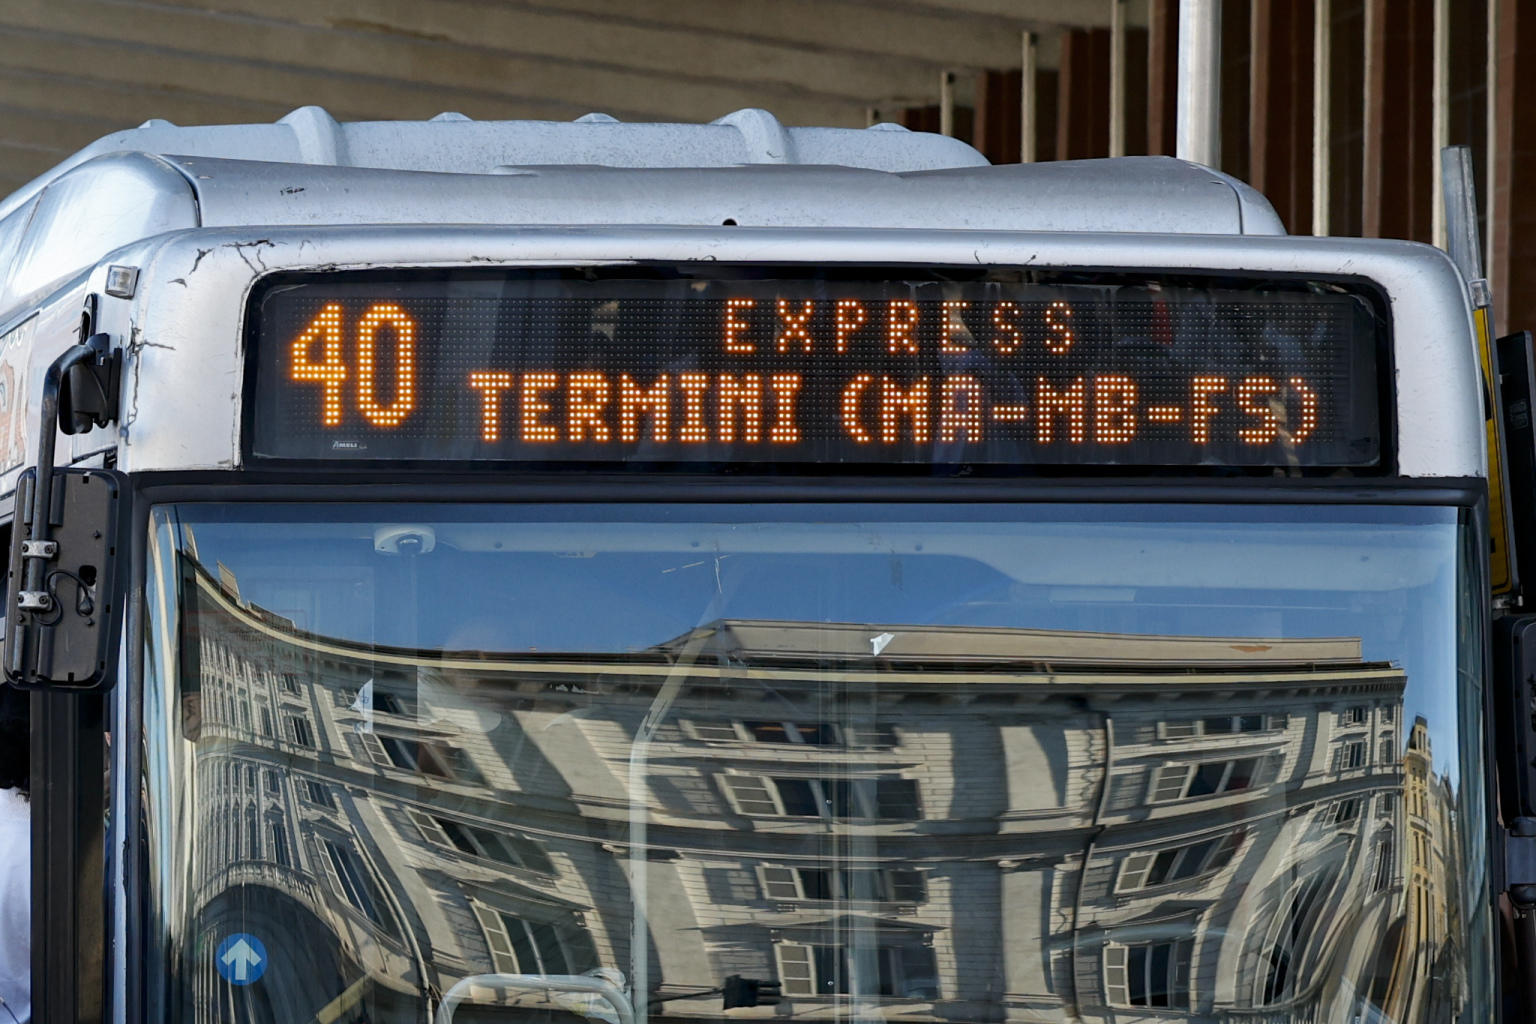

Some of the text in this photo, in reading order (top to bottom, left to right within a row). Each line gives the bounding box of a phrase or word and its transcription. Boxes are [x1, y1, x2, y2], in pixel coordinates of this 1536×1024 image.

[723, 298, 1072, 354] EXPRESS
[291, 303, 414, 427] 40
[468, 371, 1317, 444] TERMINI (MA-MB-FS)
